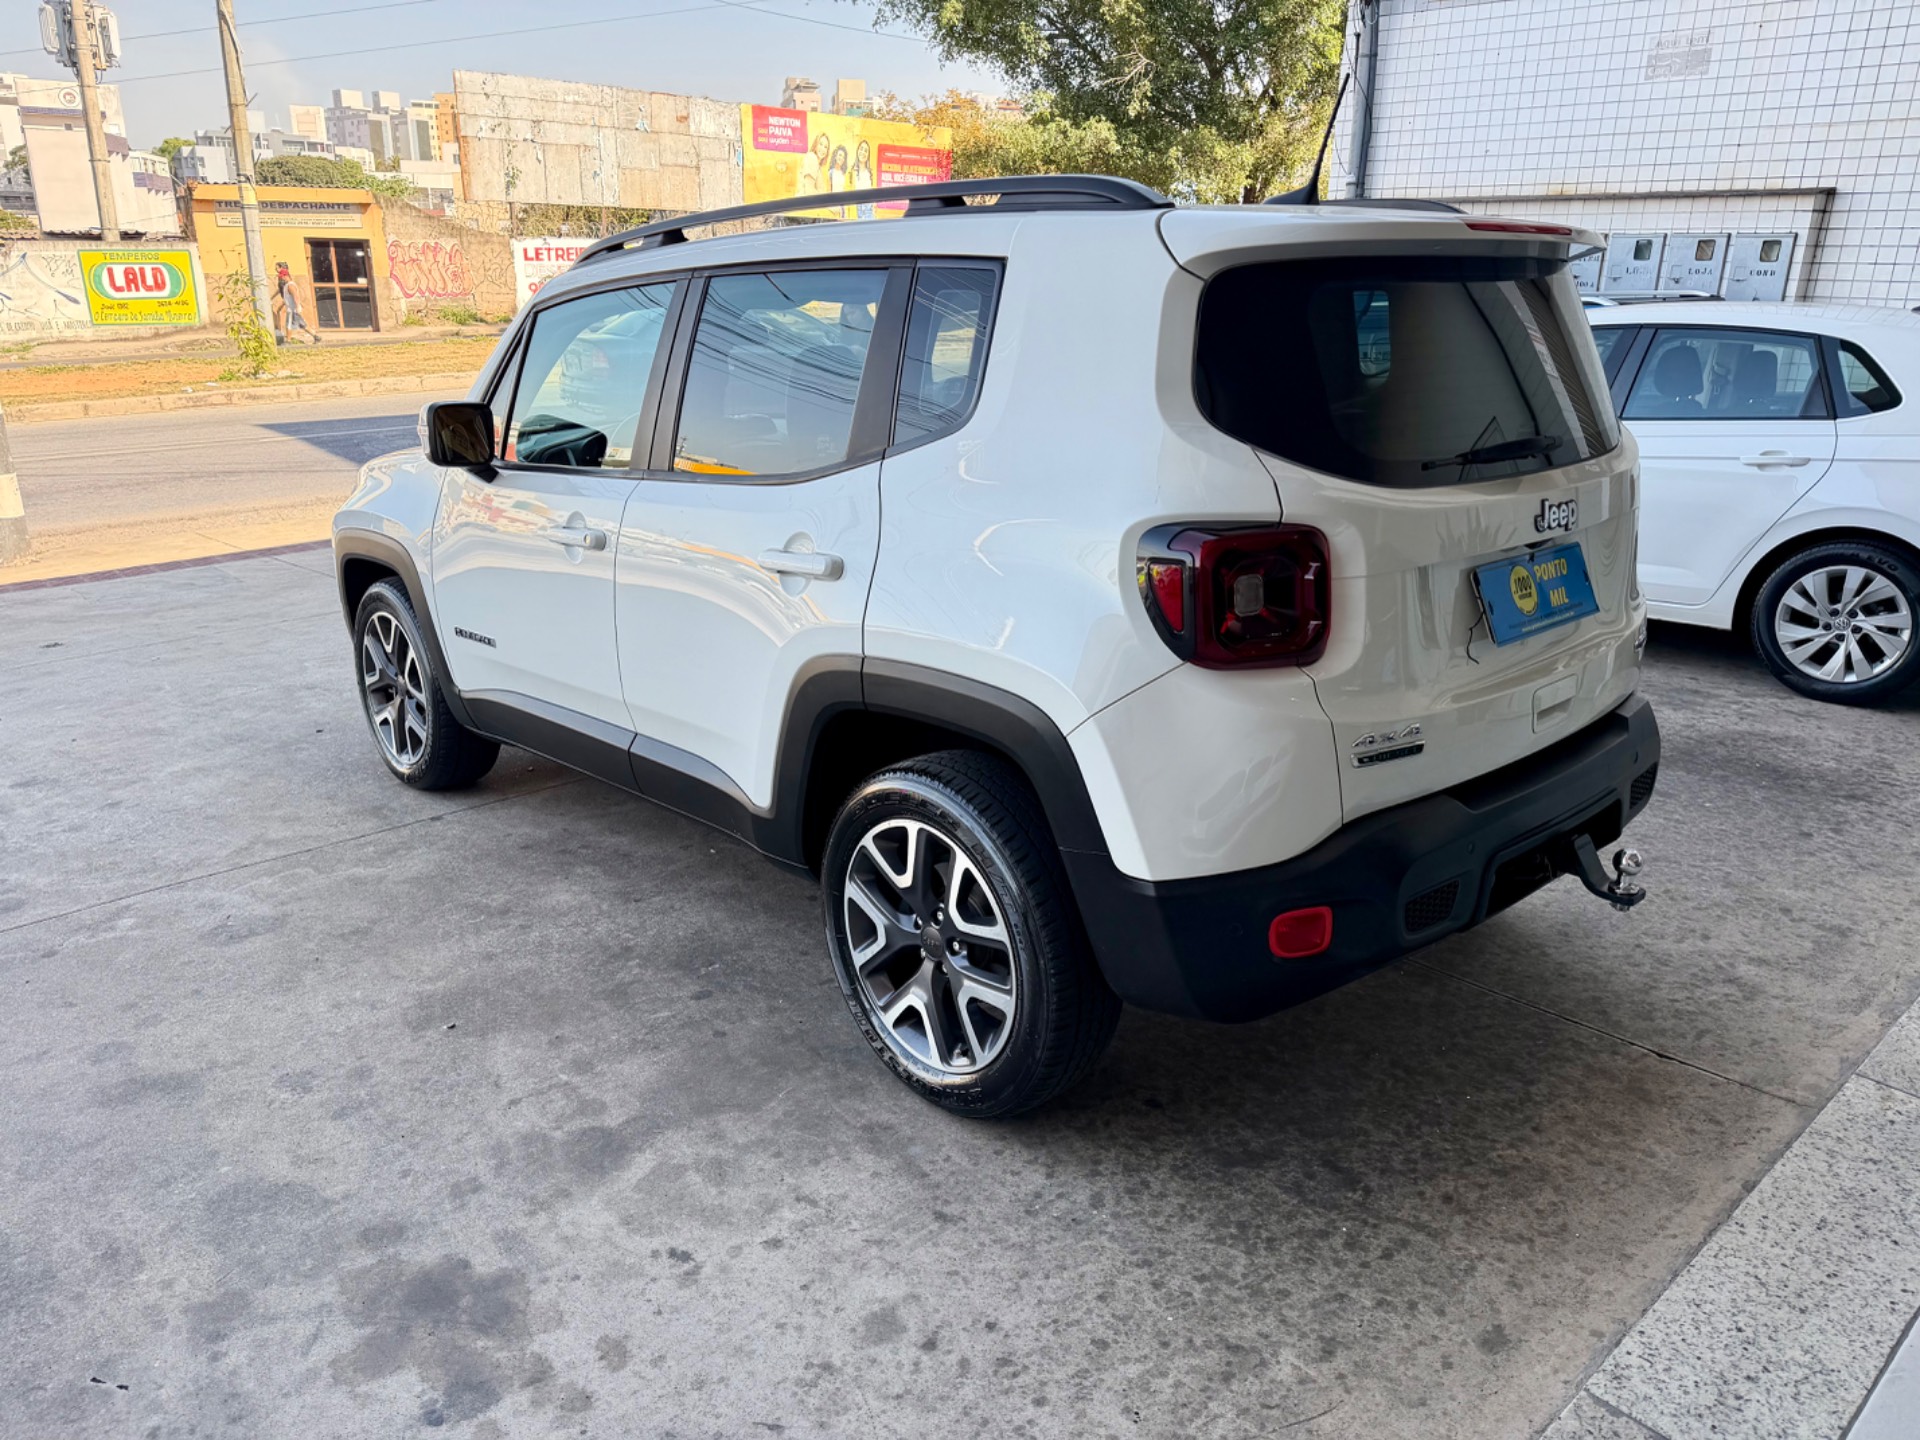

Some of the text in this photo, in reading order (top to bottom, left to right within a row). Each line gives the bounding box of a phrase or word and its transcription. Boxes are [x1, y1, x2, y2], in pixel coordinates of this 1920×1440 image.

[768, 115, 801, 128] NEWTON
[768, 125, 793, 137] PAIVA
[216, 200, 351, 210] TRE DESPACHANTE
[101, 251, 160, 261] TEMPEROS
[1688, 267, 1713, 275] LOJA
[1534, 498, 1578, 533] Jeep
[1533, 558, 1568, 583] PONTO
[1549, 586, 1569, 608] MIL
[454, 626, 497, 649] RENEGADE
